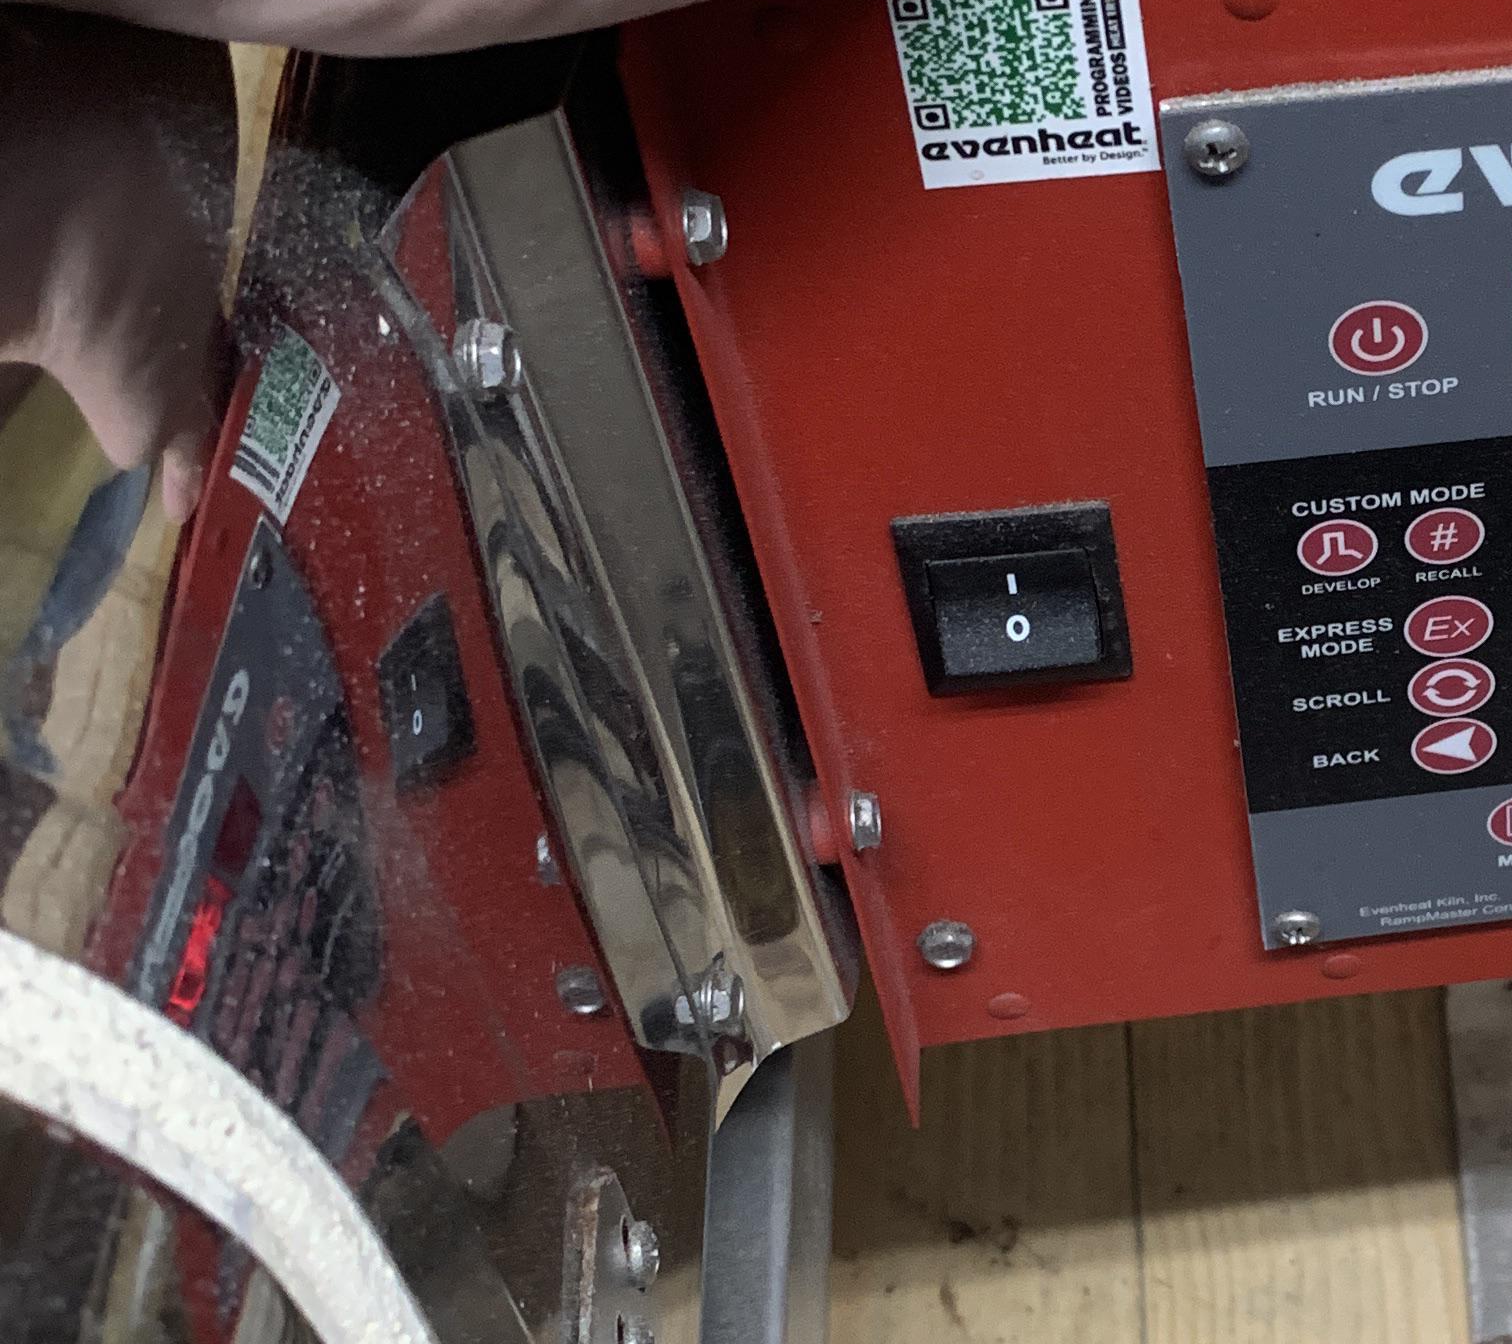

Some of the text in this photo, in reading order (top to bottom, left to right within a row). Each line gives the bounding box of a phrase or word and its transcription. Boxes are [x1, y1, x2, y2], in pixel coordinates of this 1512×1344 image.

[1111, 52, 1134, 115] VIDEOS
[922, 121, 1142, 161] evenheat
[1043, 154, 1078, 165] Better
[1082, 154, 1096, 163] by
[1307, 377, 1460, 407] RUN / STOP
[1291, 482, 1486, 517] CUSTOM MODE
[1415, 566, 1482, 583] RECALL
[1301, 577, 1381, 595] DEVELOP
[1278, 617, 1394, 643] EXPRESS
[1301, 637, 1374, 658] MODE
[1292, 689, 1391, 712] SCROLL
[1313, 749, 1380, 768] BACK
[1359, 899, 1432, 918] Evenheat
[1380, 907, 1478, 927] RampMaster
